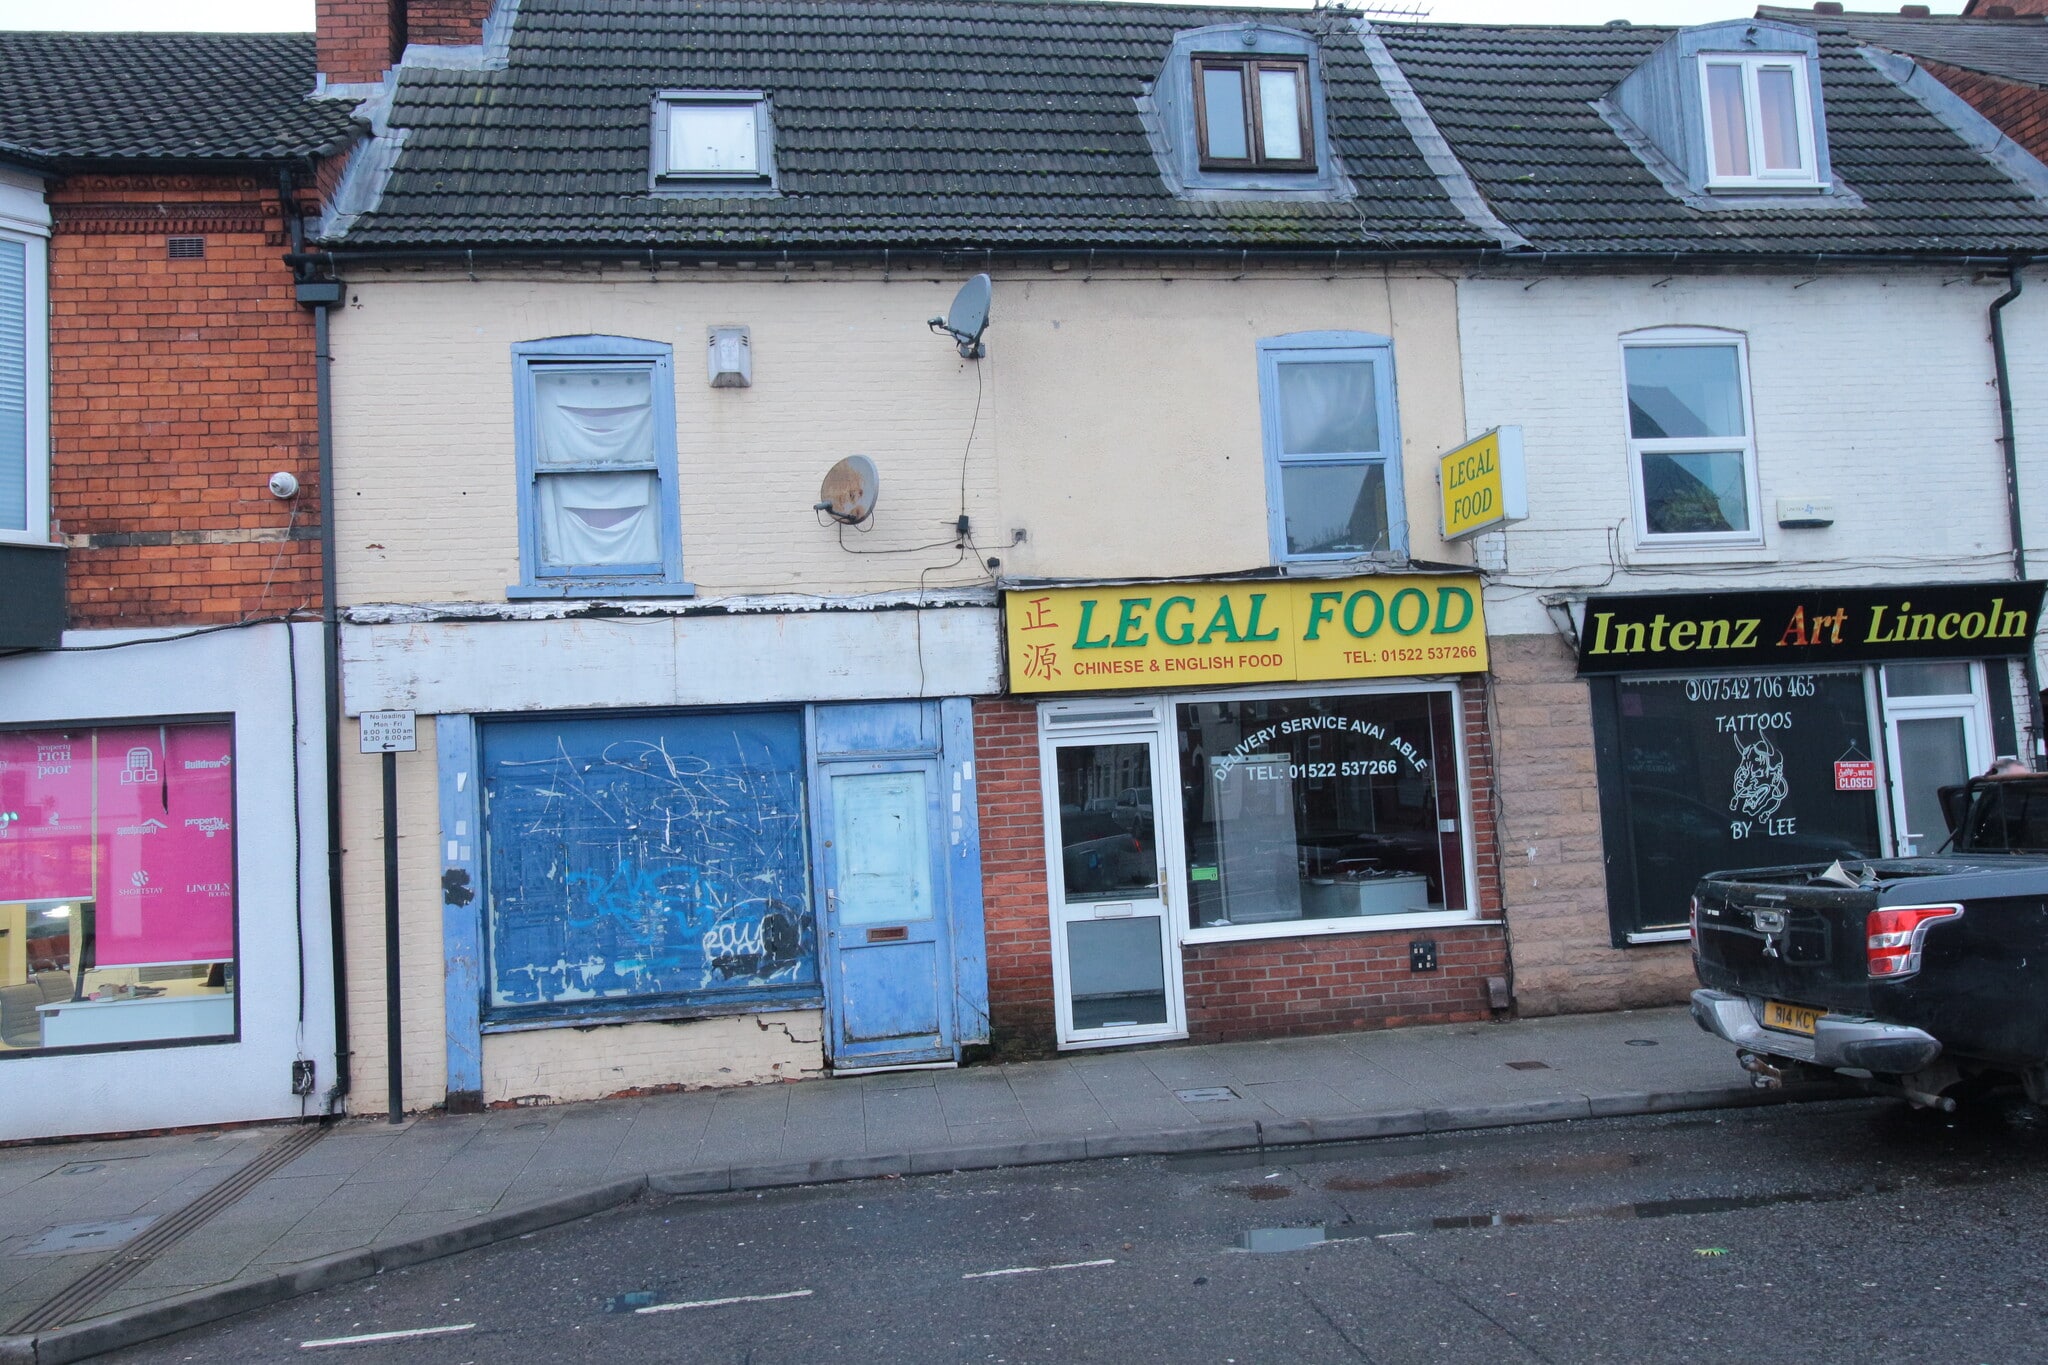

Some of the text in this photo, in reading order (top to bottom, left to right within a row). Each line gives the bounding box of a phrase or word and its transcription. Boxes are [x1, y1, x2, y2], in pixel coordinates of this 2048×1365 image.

[1449, 448, 1494, 490] LEGAL
[1453, 487, 1492, 524] FOOD
[1072, 587, 1474, 650] LEGAL FOOD
[1588, 598, 2028, 655] Intenz Art Lincoln
[1073, 653, 1283, 676] CHINESE & ENGLISH FOOD
[1343, 645, 1477, 664] TEL: 01522 537266
[1702, 675, 1815, 700] 07542 706 465
[1715, 711, 1792, 733] TATTOOS
[1214, 725, 1277, 782] DELIVERY
[1281, 716, 1348, 735] SERVICE
[37, 765, 72, 779] poor
[1246, 759, 1397, 781] TEL: 01522 537266
[1840, 777, 1873, 788] CLOSED
[1730, 817, 1797, 840] BY LEE
[186, 882, 231, 893] LINCOLN
